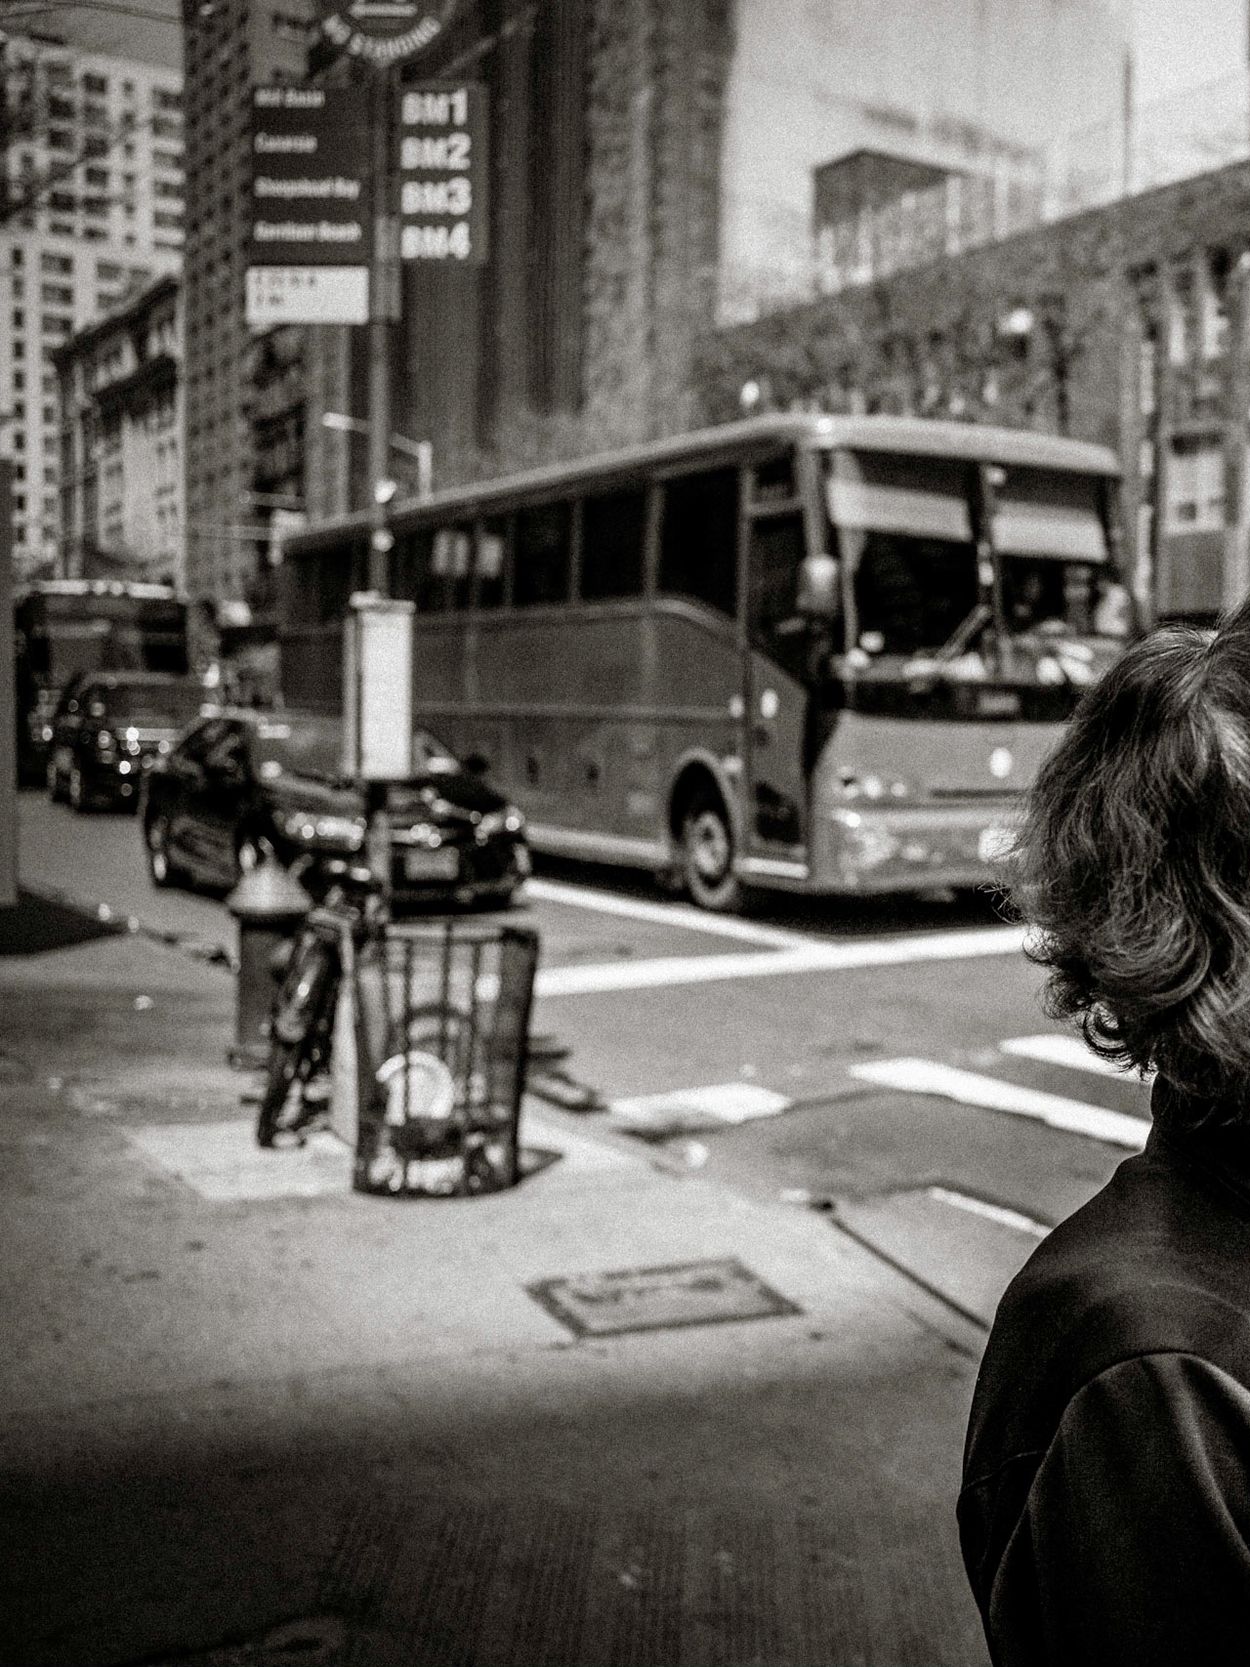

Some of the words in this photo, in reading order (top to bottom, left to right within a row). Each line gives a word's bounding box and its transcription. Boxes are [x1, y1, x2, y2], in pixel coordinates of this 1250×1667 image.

[402, 88, 467, 125] BM1
[401, 133, 471, 170] BM2
[402, 177, 472, 215] BM3
[401, 221, 471, 260] BM4
